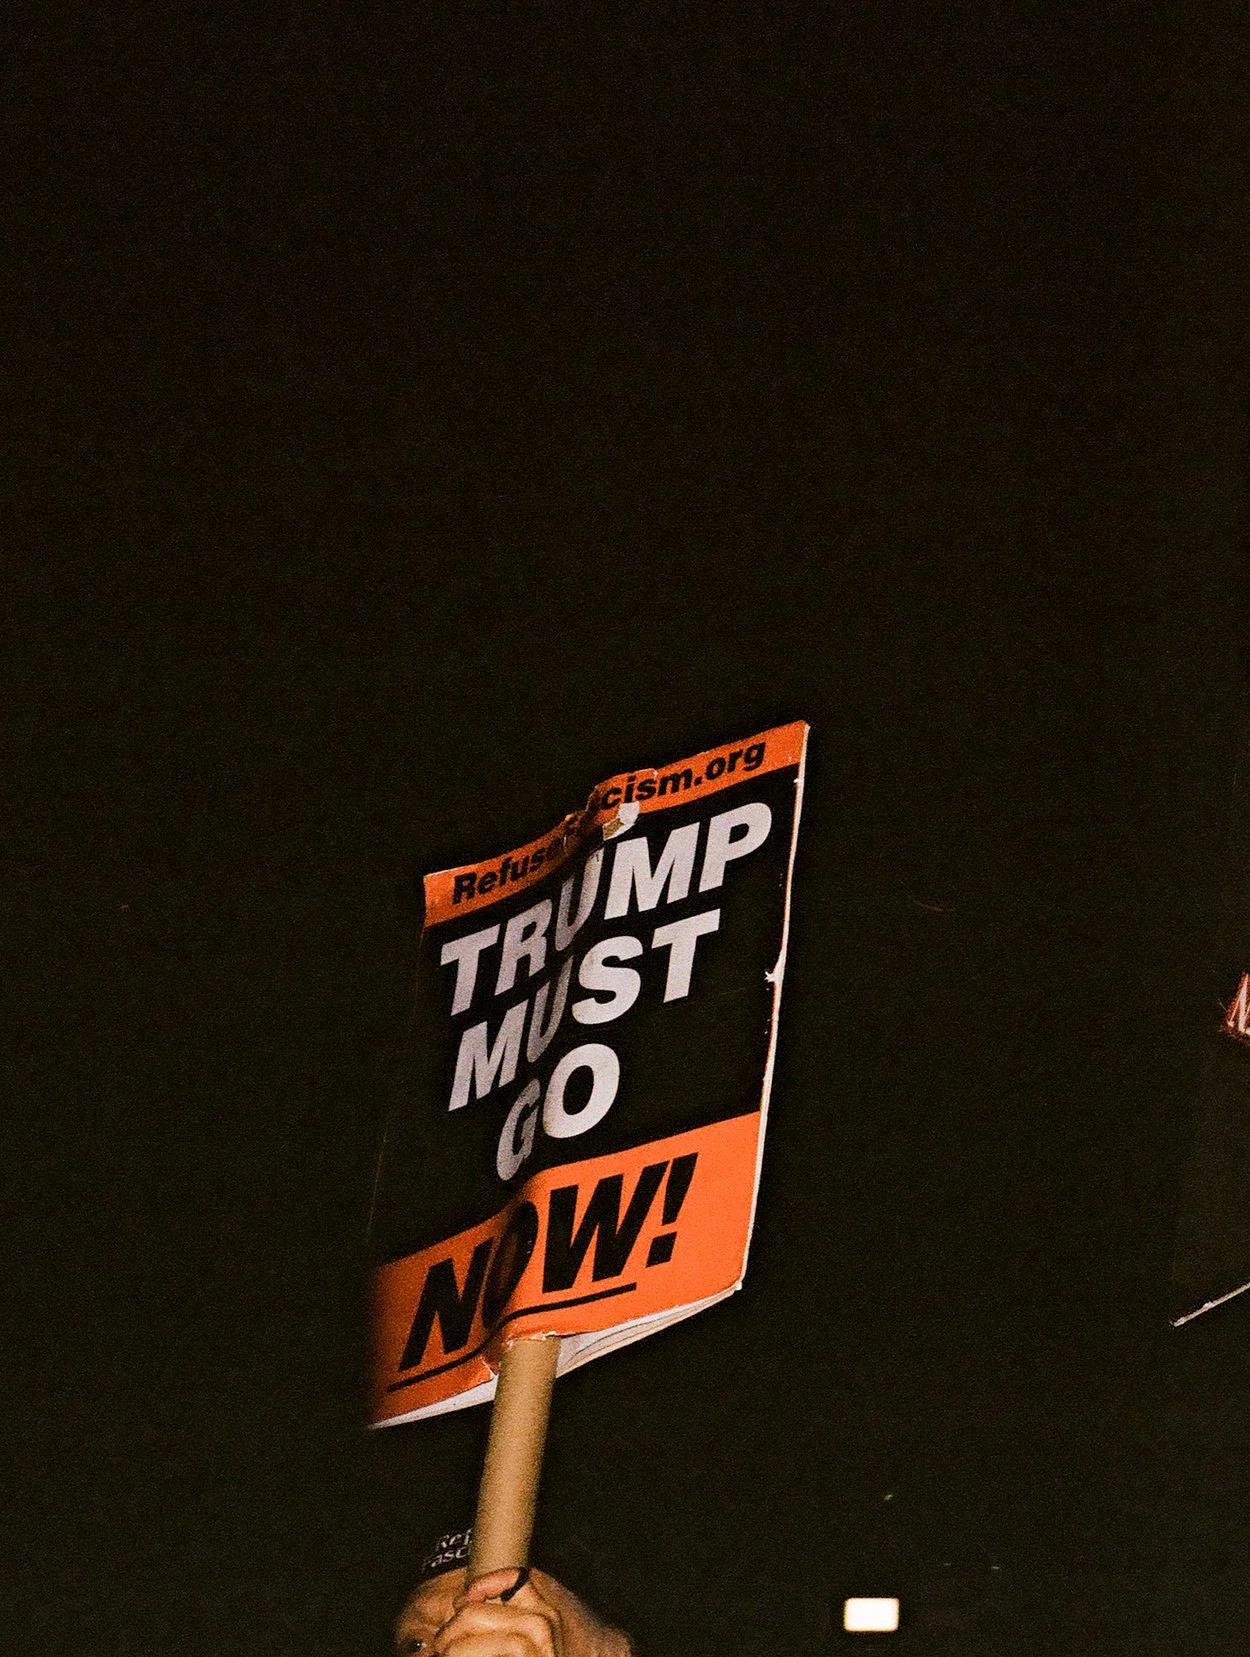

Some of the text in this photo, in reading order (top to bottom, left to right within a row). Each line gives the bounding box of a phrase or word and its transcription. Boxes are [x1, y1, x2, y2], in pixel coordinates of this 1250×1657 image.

[440, 802, 772, 1017] TRUMP
[448, 908, 722, 1112] MUST
[496, 1043, 621, 1181] GO
[398, 1151, 699, 1374] NOW!
